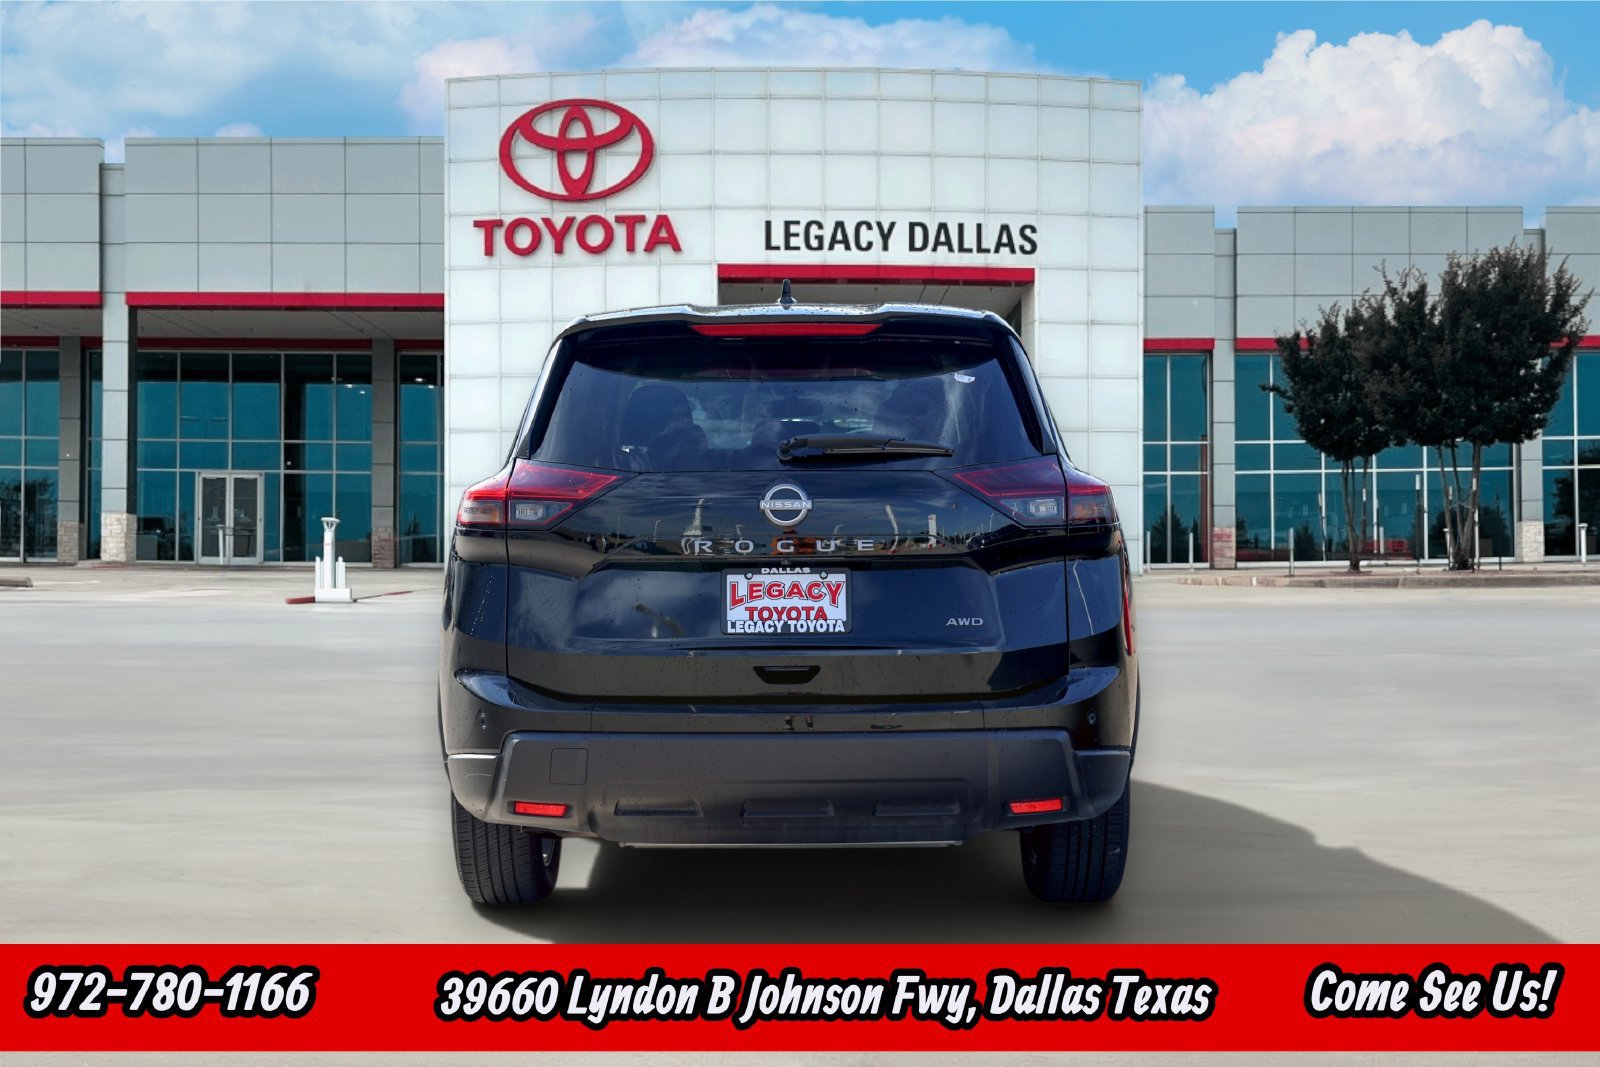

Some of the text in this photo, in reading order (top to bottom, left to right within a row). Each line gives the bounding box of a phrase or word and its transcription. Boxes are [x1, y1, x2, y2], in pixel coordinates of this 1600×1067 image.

[473, 214, 682, 257] TOYOTA
[764, 219, 1039, 255] LEGACY DALLAS
[761, 500, 811, 508] NISSAN
[694, 539, 875, 553] ROGUE
[729, 581, 845, 610] LEGACY
[745, 606, 828, 621] TOYOTA
[727, 619, 845, 633] LEGACY TOYOTA
[946, 617, 984, 626] AWD
